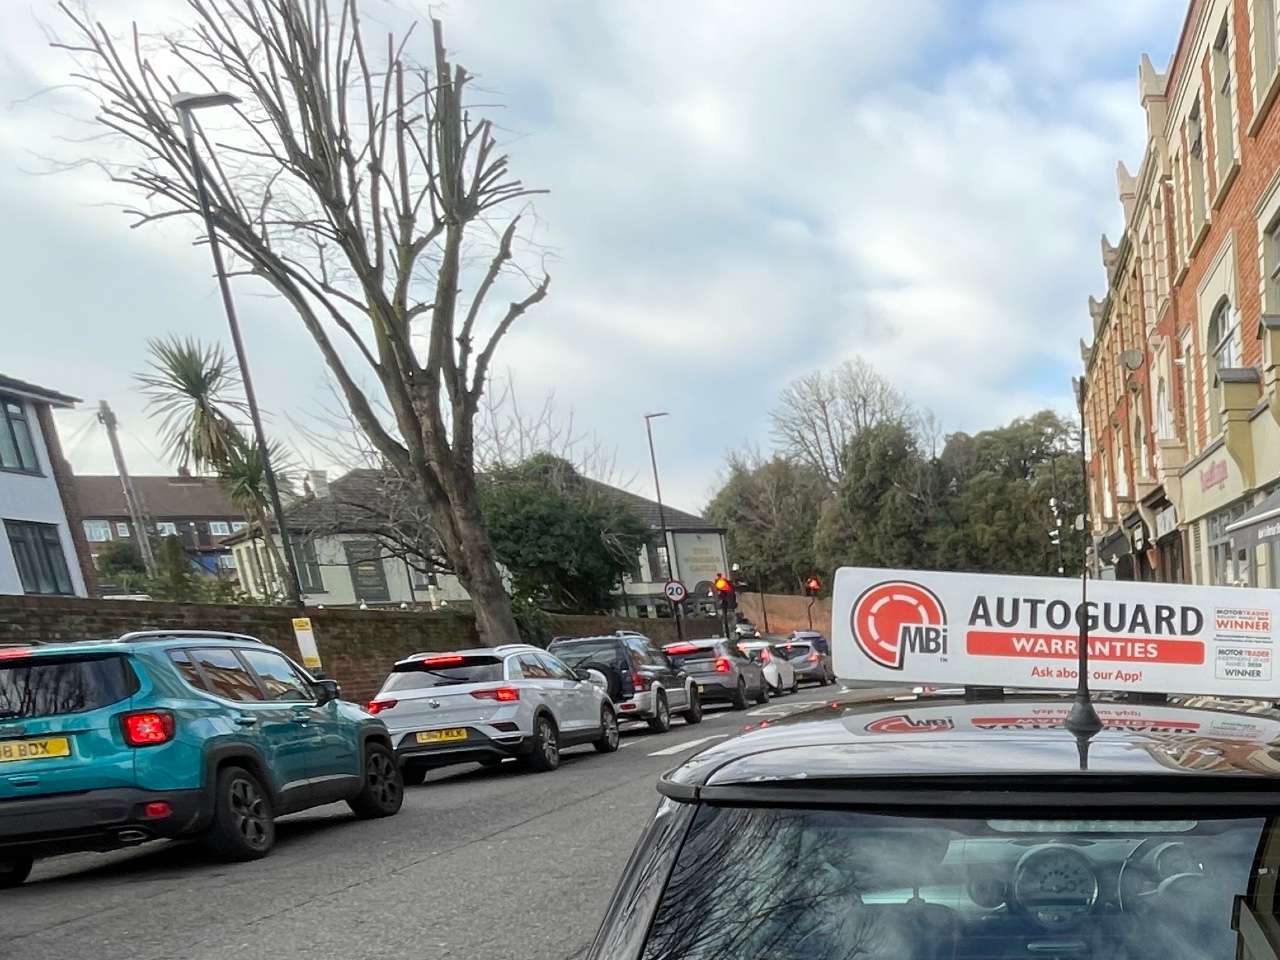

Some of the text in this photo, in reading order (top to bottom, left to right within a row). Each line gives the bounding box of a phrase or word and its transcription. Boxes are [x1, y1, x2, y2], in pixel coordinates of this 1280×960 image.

[667, 586, 683, 596] 20
[968, 595, 1205, 636] AUTOGUARD
[1216, 620, 1270, 631] WINNER
[900, 625, 948, 655] MBi
[1031, 666, 1053, 678] Ask
[1093, 671, 1113, 681] our
[1115, 670, 1143, 683] App!
[1224, 668, 1262, 678] WINNER
